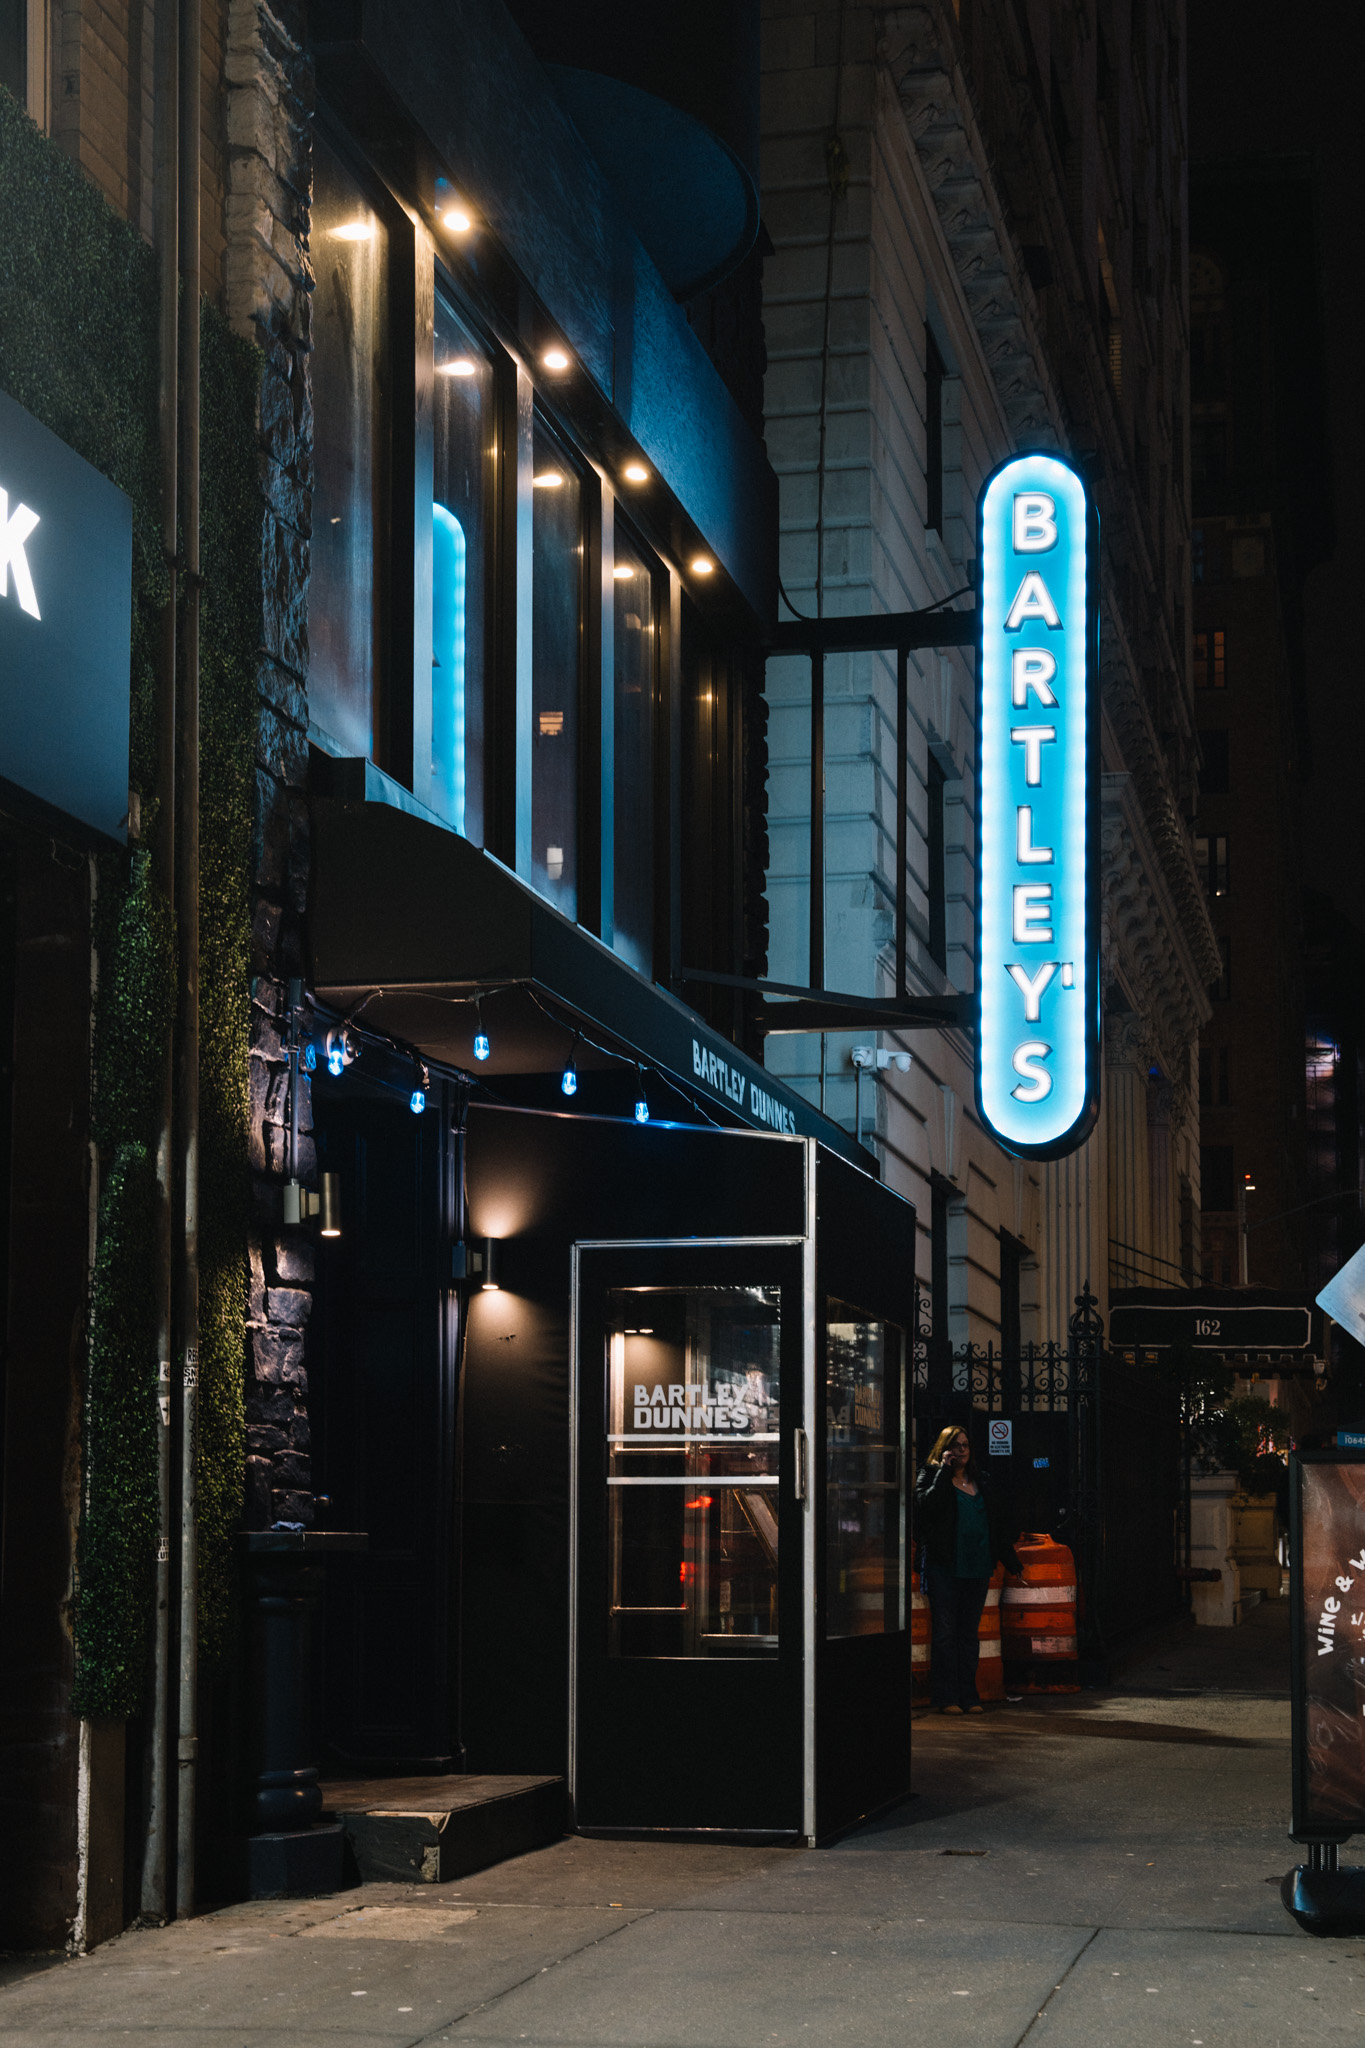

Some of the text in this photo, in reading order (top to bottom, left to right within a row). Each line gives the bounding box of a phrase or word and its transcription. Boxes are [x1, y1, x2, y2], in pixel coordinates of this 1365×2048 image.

[1004, 492, 1076, 1105] BARTLEY'S
[693, 1039, 796, 1135] BARTLEY DUNNES
[1195, 1319, 1221, 1336] 162
[633, 1383, 749, 1406] BARTLEY
[633, 1406, 750, 1429] DUNNES
[1335, 1576, 1354, 1593] &
